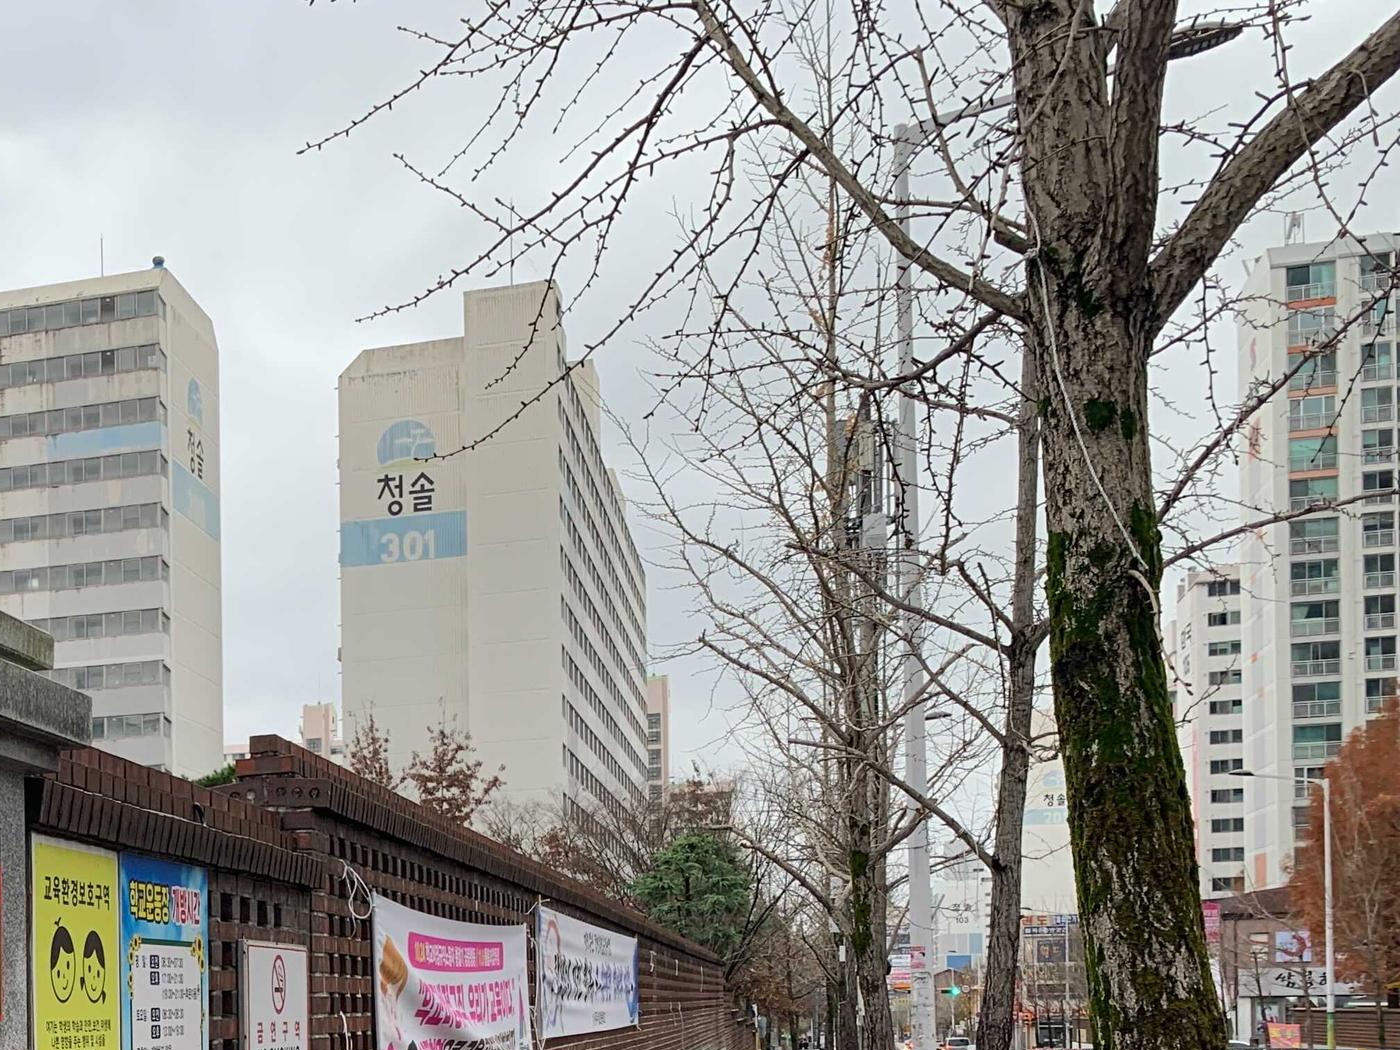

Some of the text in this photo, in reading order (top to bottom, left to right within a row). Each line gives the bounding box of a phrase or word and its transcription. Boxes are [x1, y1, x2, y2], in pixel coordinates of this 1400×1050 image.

[187, 427, 204, 480] 청솔
[377, 471, 435, 516] 청솔
[380, 529, 435, 562] 301
[1043, 793, 1066, 807] 청솔
[44, 875, 110, 911] 교육환경보호구역
[129, 880, 201, 928] 학교운동장 개방시간
